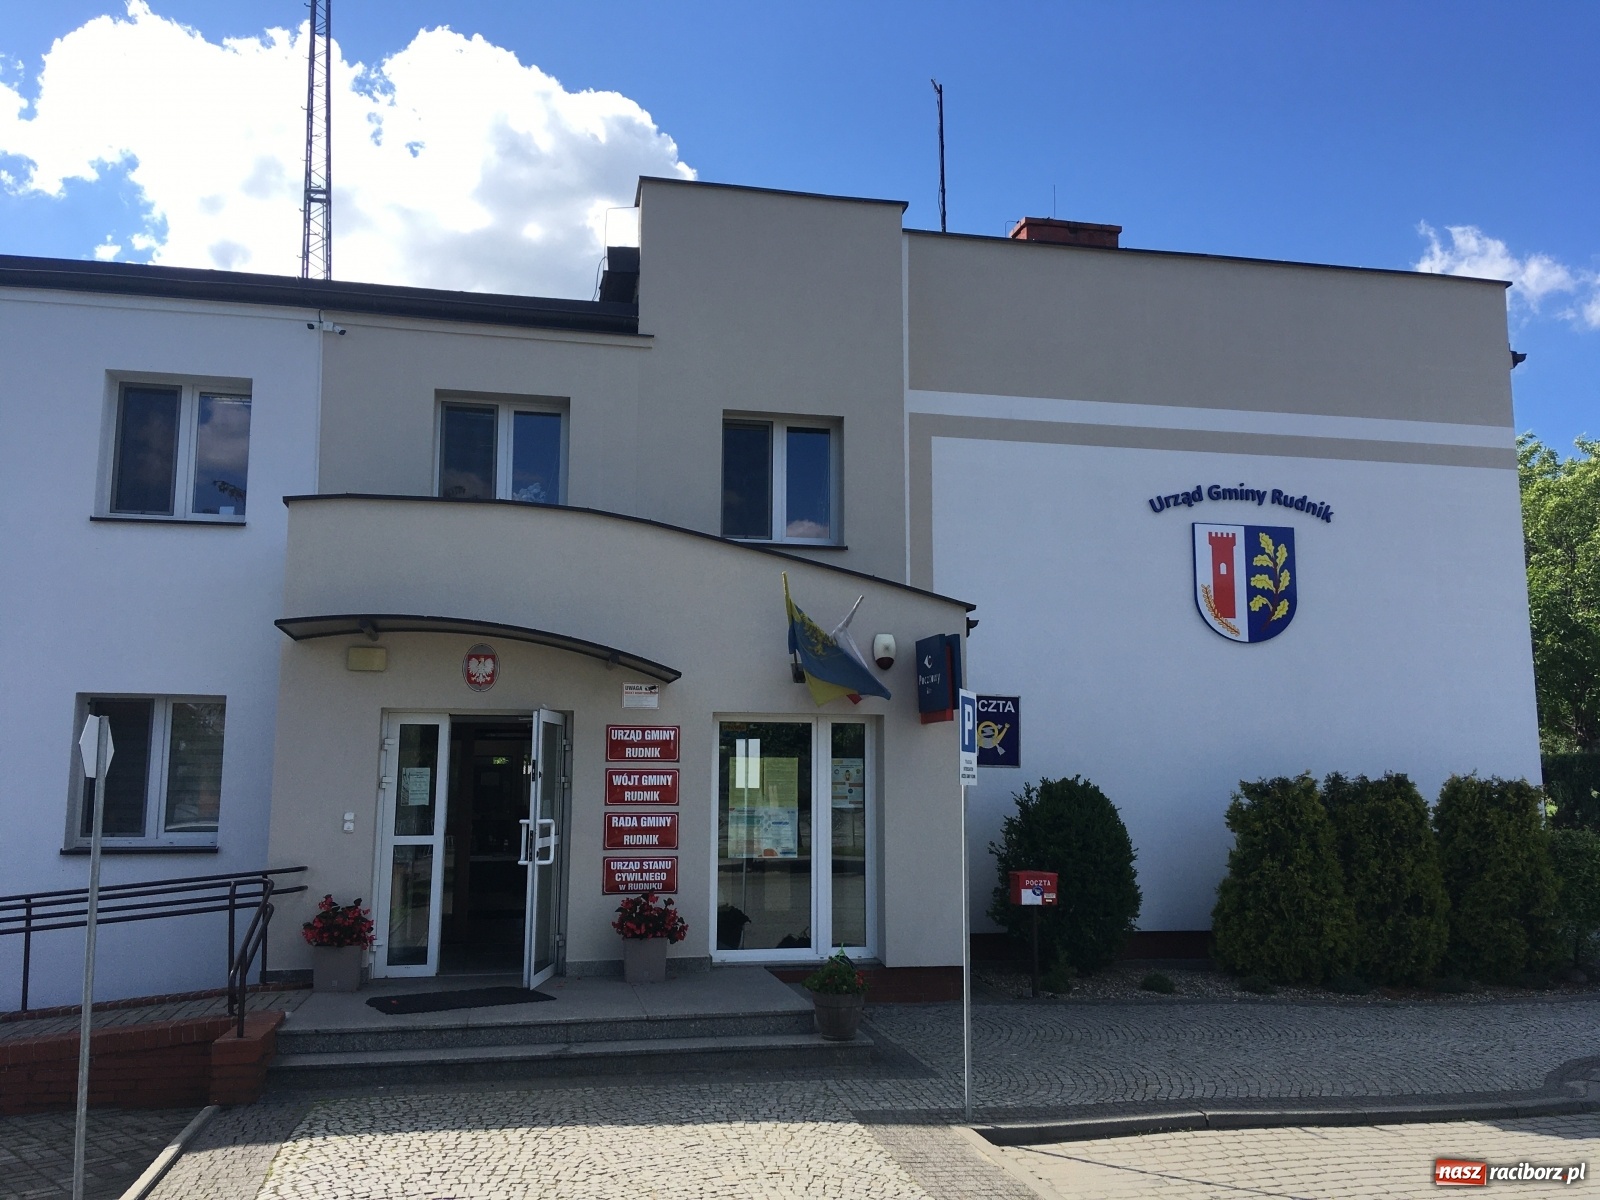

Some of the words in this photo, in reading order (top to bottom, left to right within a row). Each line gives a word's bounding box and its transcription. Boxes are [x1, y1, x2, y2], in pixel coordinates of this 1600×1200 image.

[1149, 485, 1203, 513] Urząd
[1207, 483, 1267, 506] Gminy
[1271, 488, 1334, 523] Rudnik
[976, 700, 1015, 713] CZTA
[965, 704, 972, 745] P
[611, 730, 642, 742] URZĄD
[645, 730, 675, 740] GMINY
[625, 747, 661, 758] RUDNIK
[612, 773, 639, 786] WÓJT
[641, 775, 672, 786] GMINY
[624, 791, 660, 801] RUDNIK
[612, 817, 638, 827] RADA
[640, 817, 671, 827] GMINY
[623, 835, 659, 845] RUDNIK
[611, 861, 640, 871] URZĄD
[643, 861, 671, 869] STANU
[615, 872, 666, 881] CYWILNEGO
